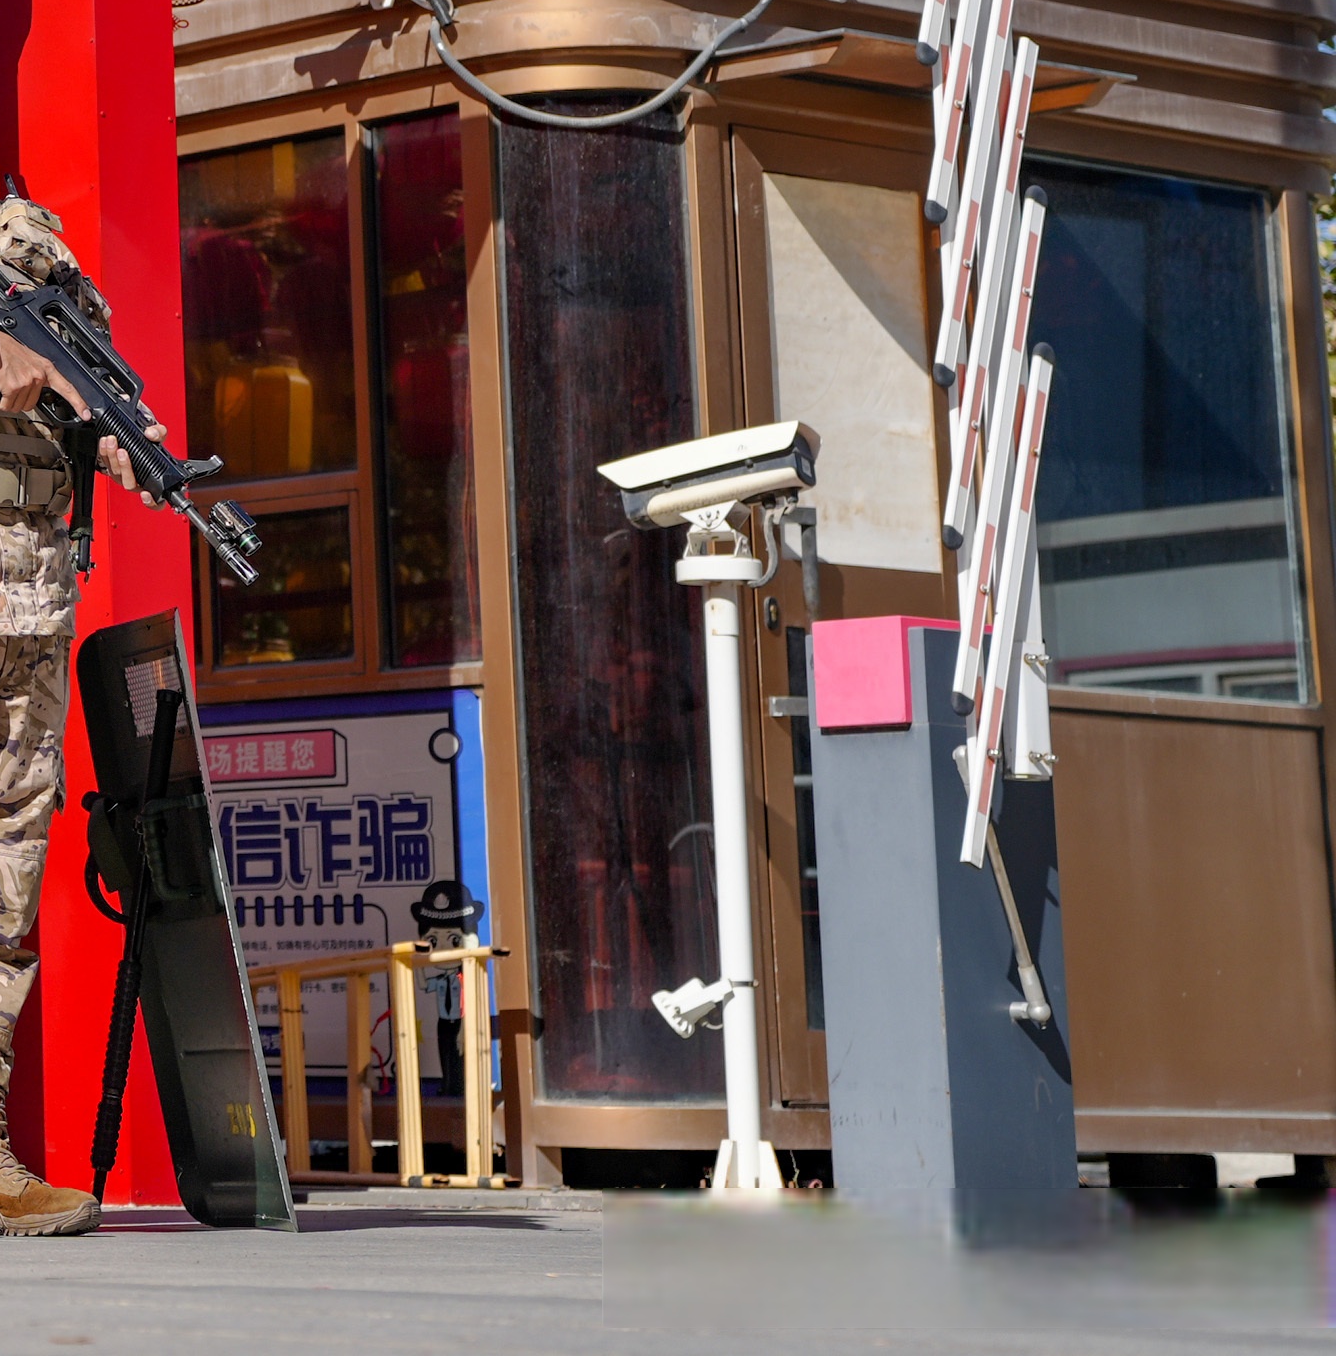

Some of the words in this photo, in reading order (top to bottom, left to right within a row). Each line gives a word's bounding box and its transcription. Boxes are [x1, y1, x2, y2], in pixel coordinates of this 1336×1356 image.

[209, 739, 316, 775] 场提醒您
[219, 798, 429, 886] 信诈骗
